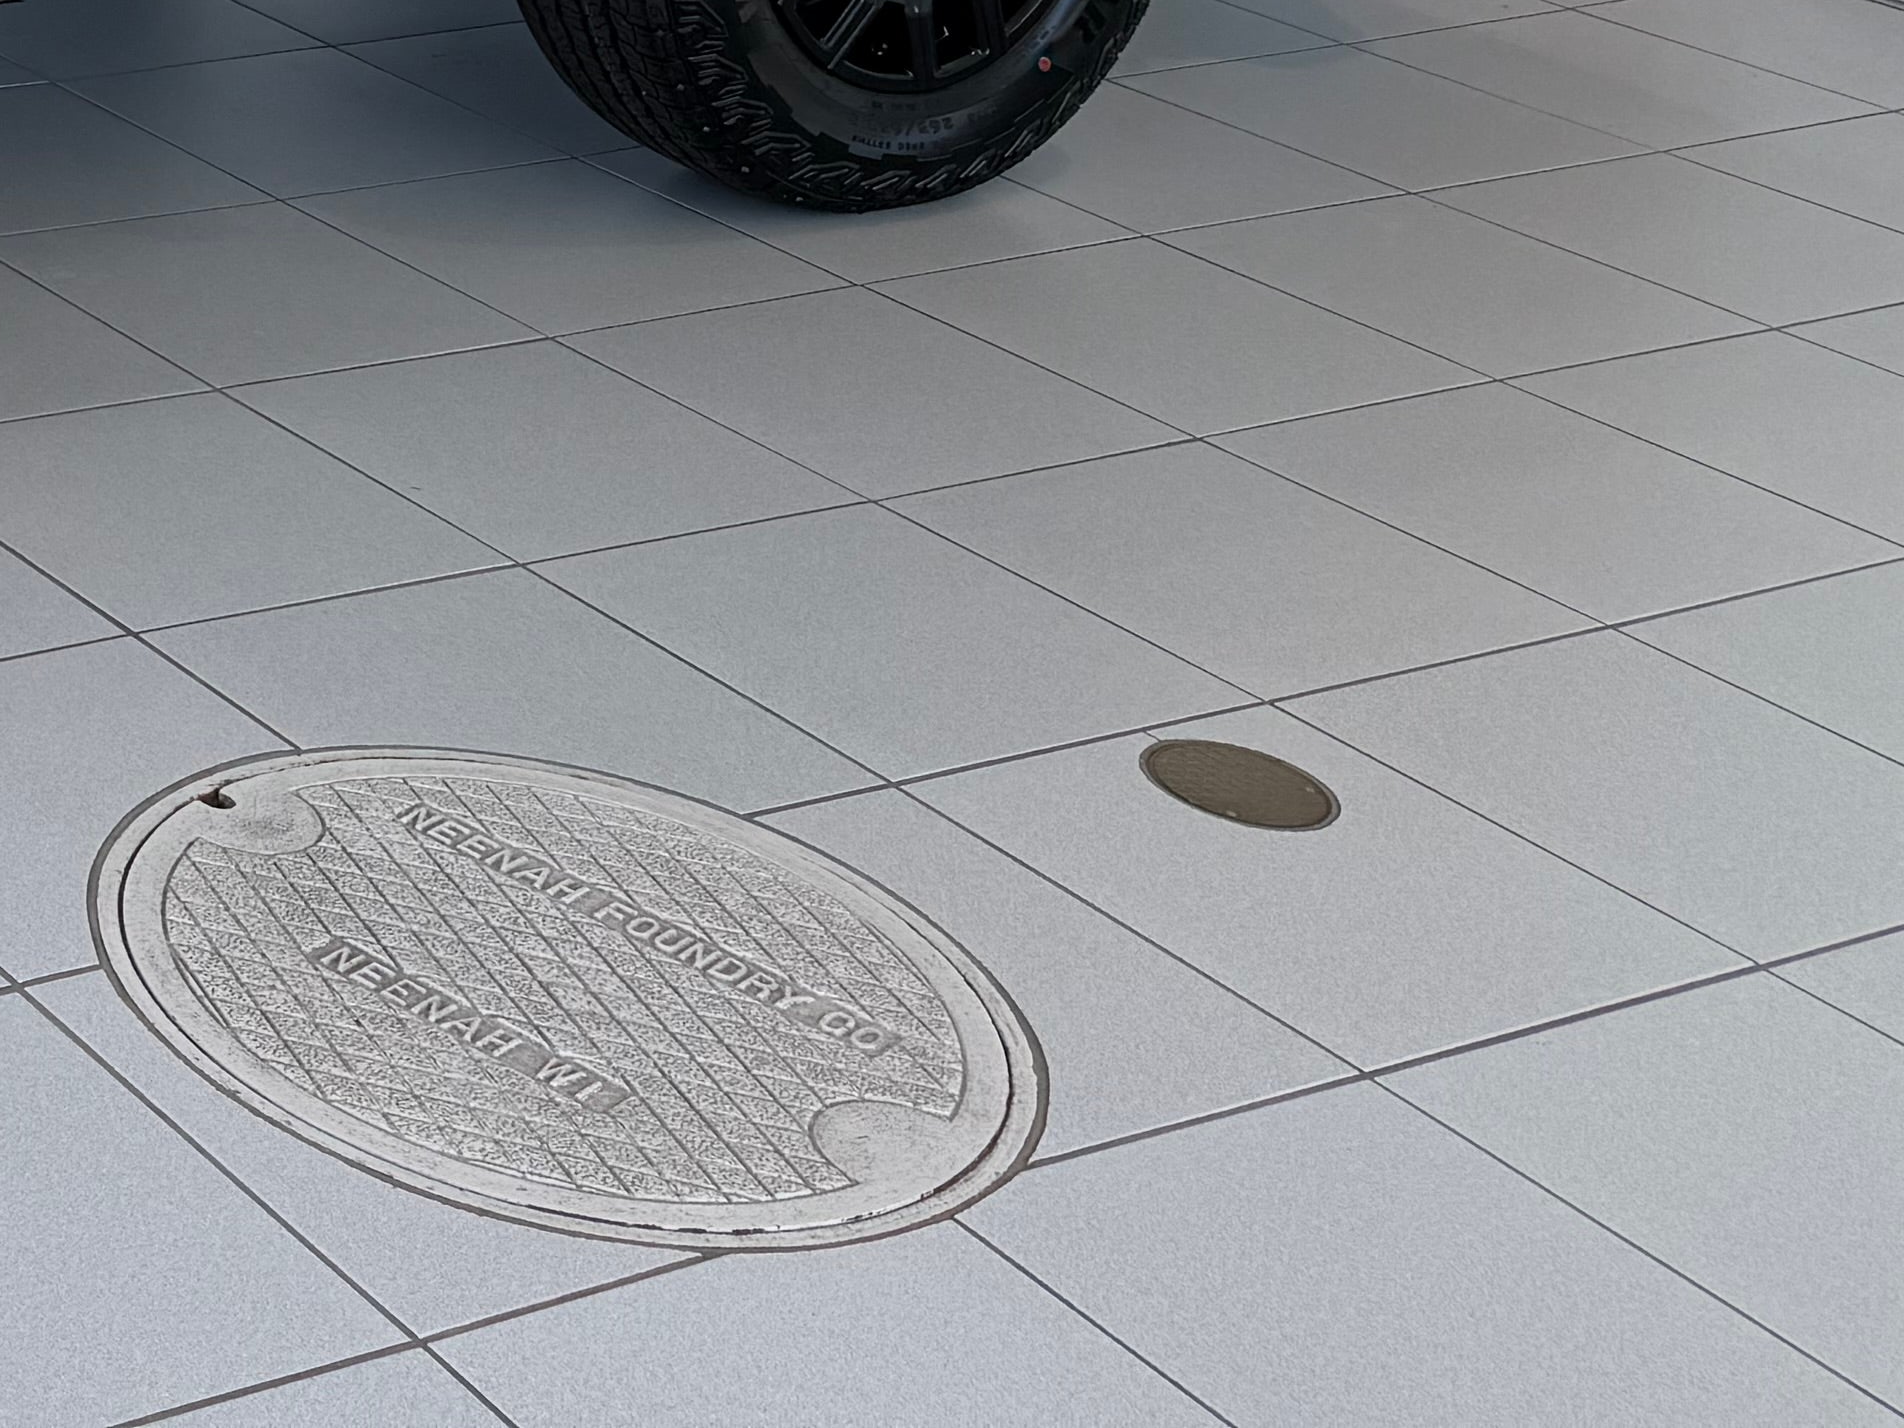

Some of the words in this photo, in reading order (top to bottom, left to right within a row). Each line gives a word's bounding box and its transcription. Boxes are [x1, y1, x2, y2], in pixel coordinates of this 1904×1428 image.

[320, 946, 523, 1058] NEENAH
[536, 1057, 604, 1103] WI
[397, 803, 590, 905] NEENAH
[594, 901, 816, 1012] FOUNDRY
[819, 1010, 889, 1055] CO
